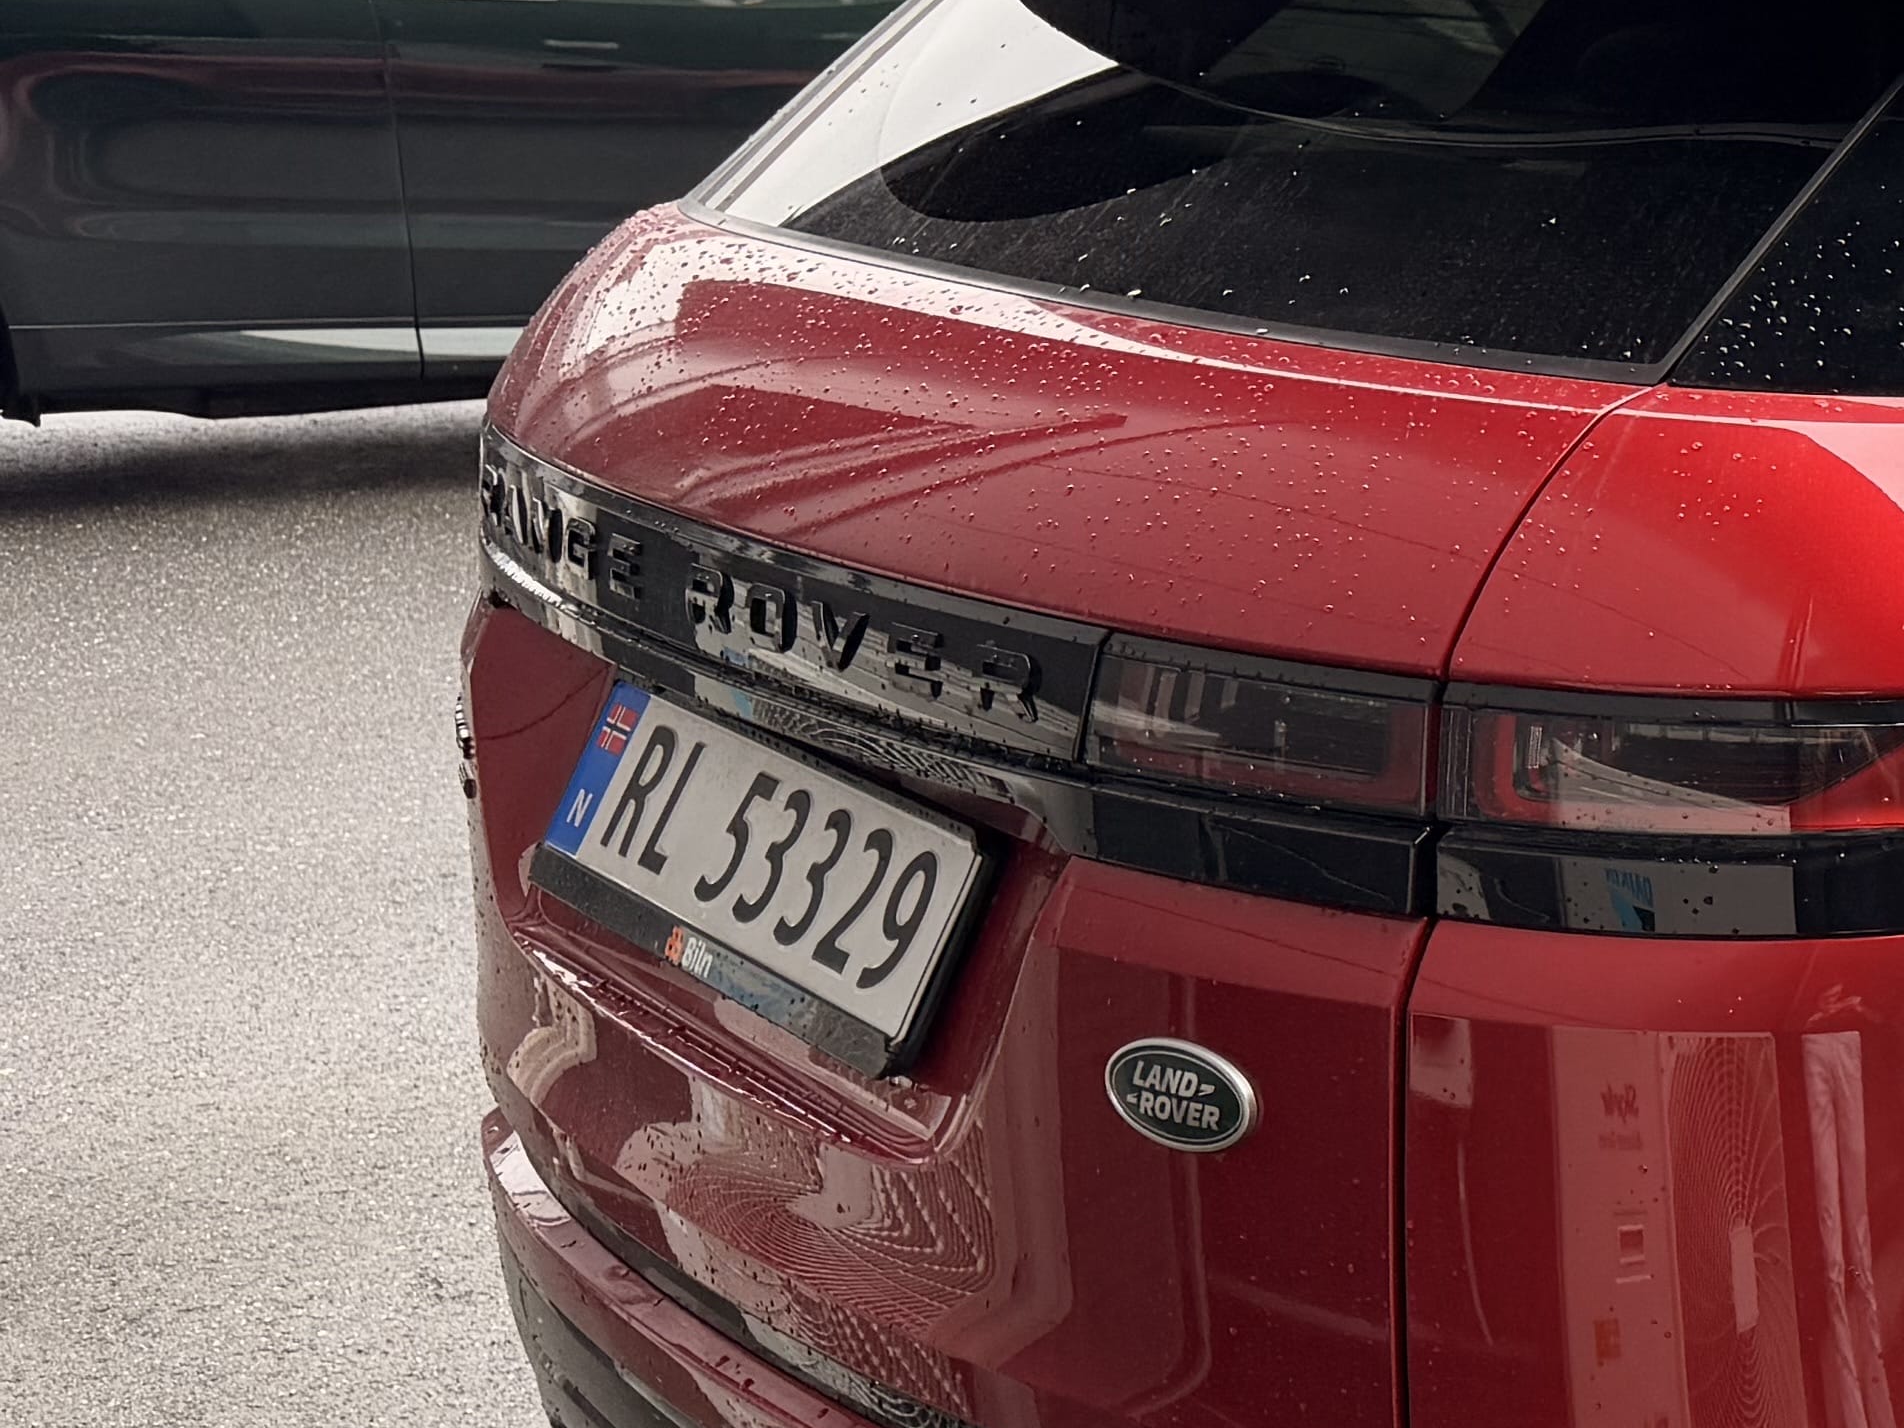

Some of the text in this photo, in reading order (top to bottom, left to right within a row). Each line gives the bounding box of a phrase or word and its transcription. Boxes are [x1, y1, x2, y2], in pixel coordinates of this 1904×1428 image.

[482, 464, 1041, 723] RANGE ROVER
[566, 788, 594, 828] N
[600, 725, 705, 875] RL
[694, 772, 938, 990] 53329
[1132, 1060, 1199, 1098] LAND
[1138, 1090, 1220, 1131] ROVER
